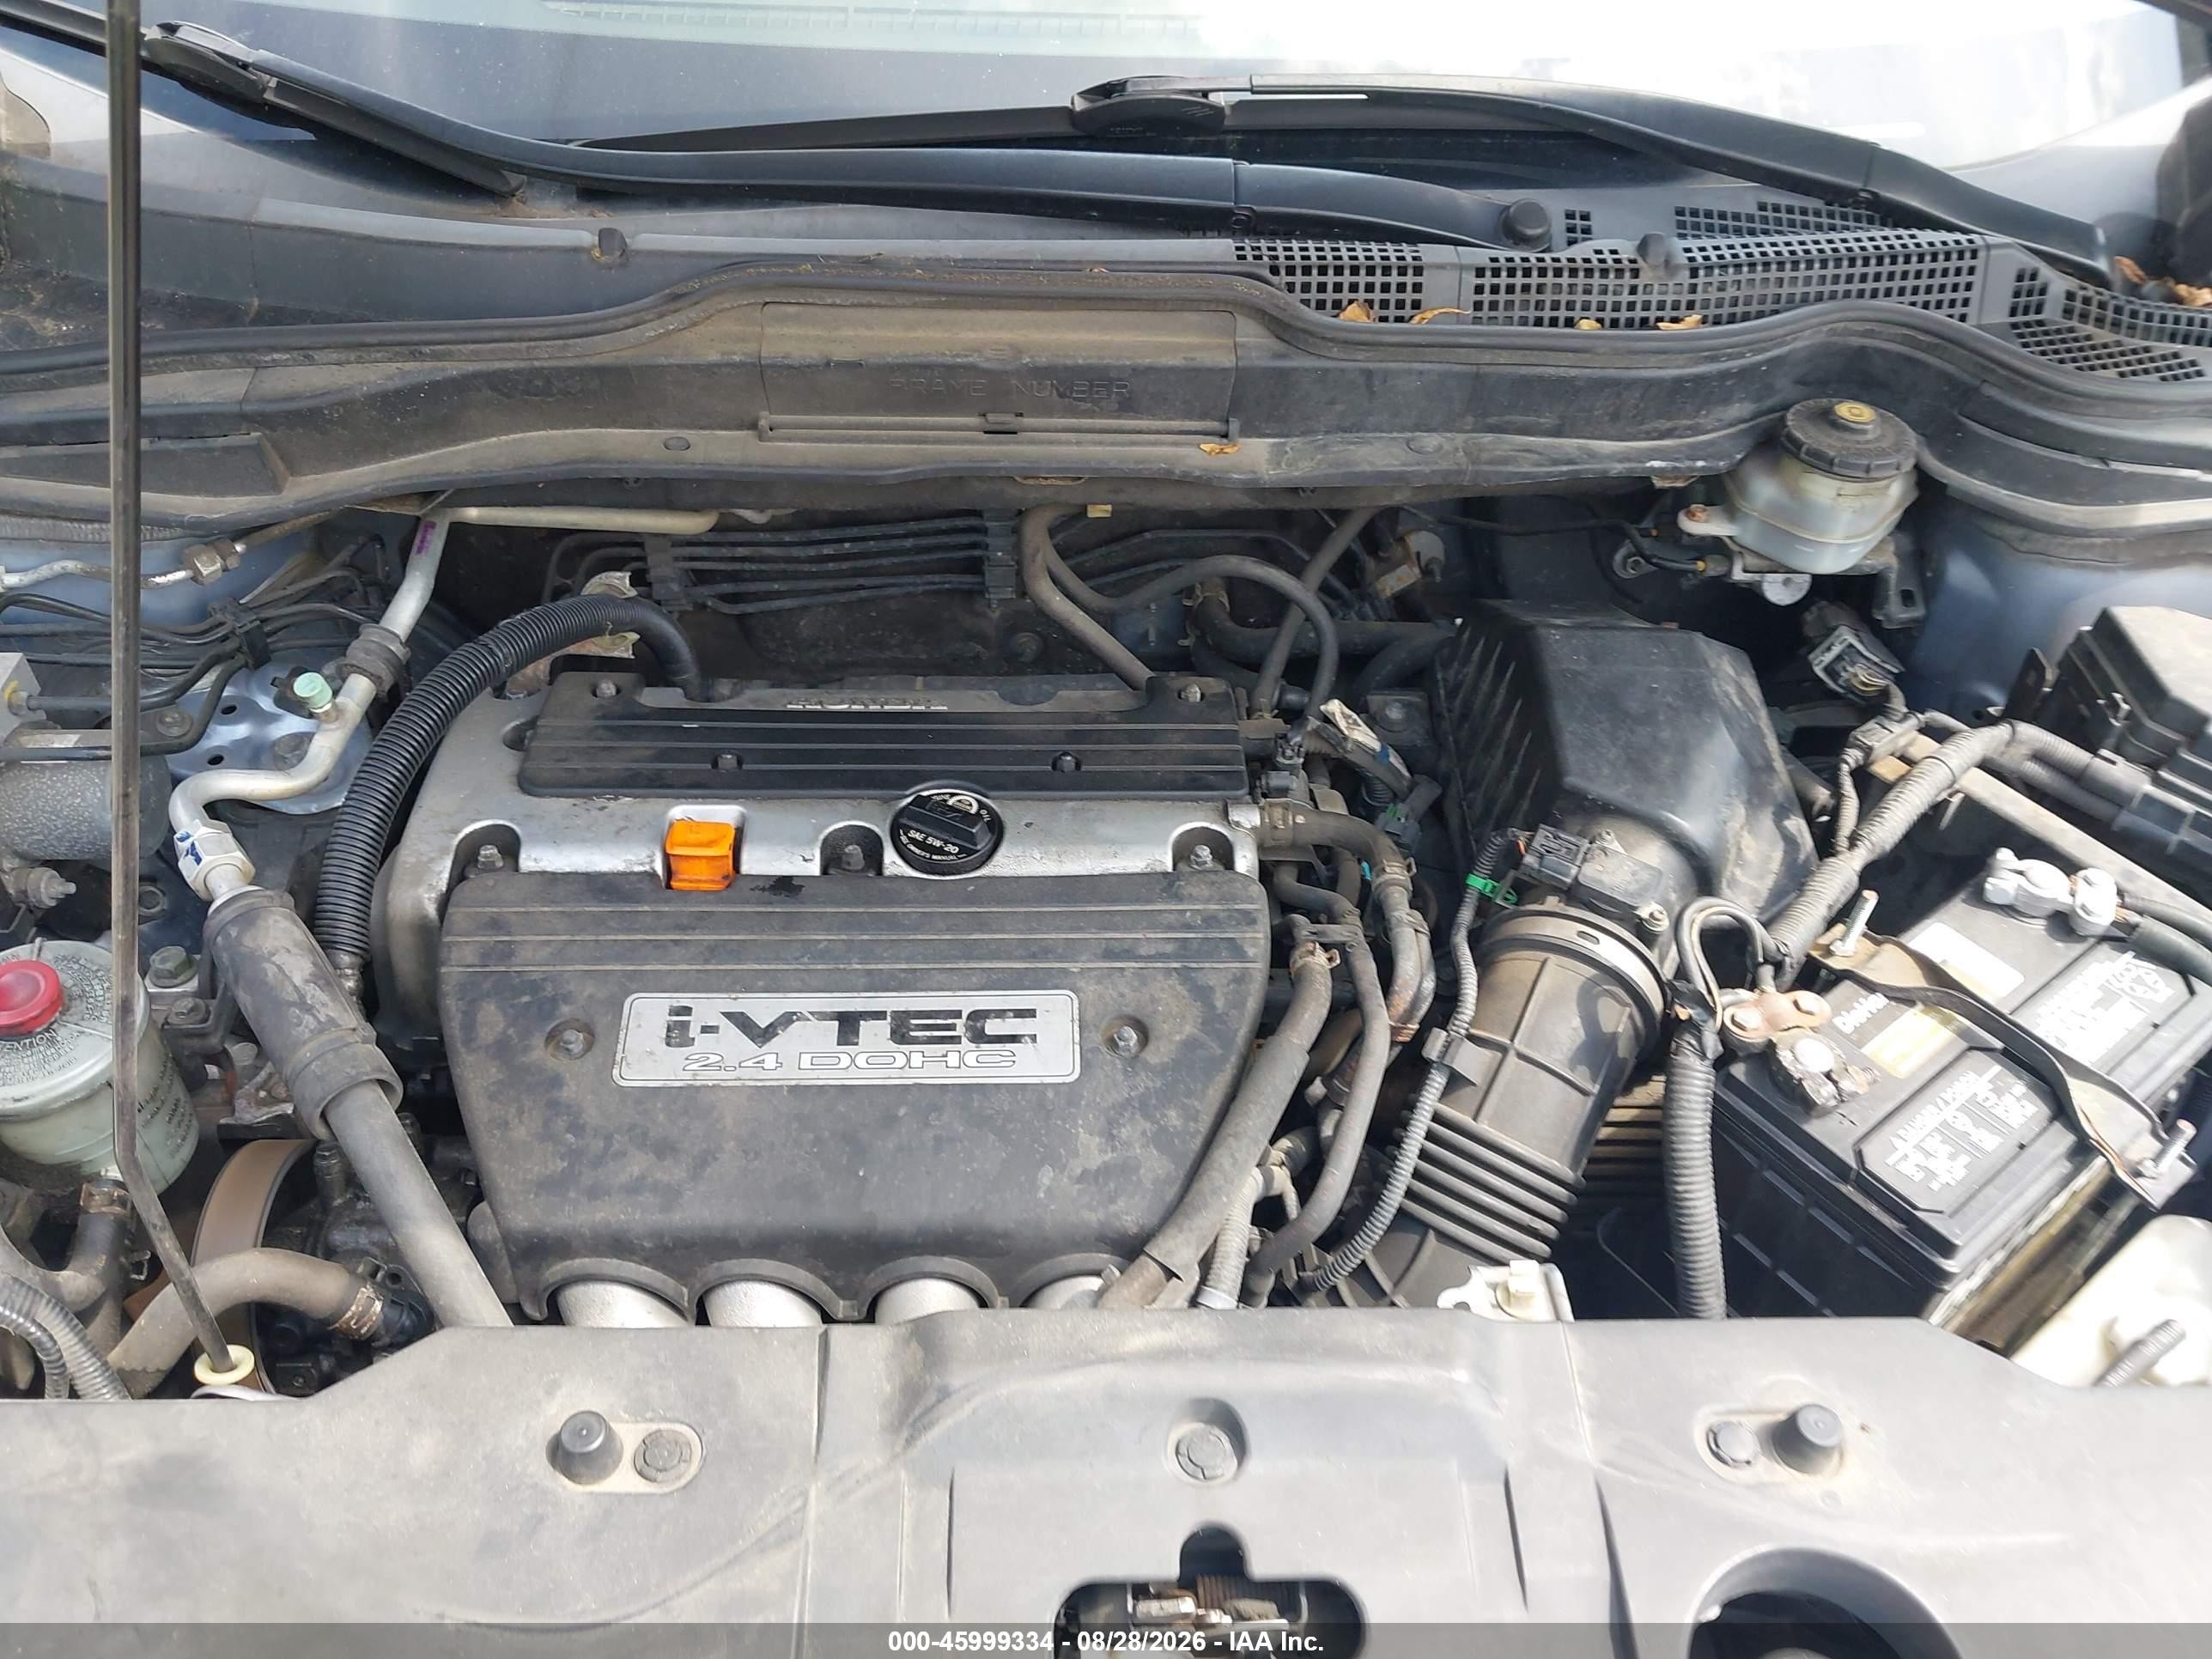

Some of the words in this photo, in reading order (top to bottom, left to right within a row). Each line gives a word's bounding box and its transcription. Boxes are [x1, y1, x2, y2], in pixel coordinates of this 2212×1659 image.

[1012, 380, 1130, 398] NUMBER
[979, 809, 992, 823] OIL
[908, 830, 927, 842] SAE
[925, 836, 959, 854] 5W-20
[665, 1005, 1037, 1048] i-VTEC
[684, 1052, 783, 1072] 2.4
[798, 1050, 1017, 1070] DOHC
